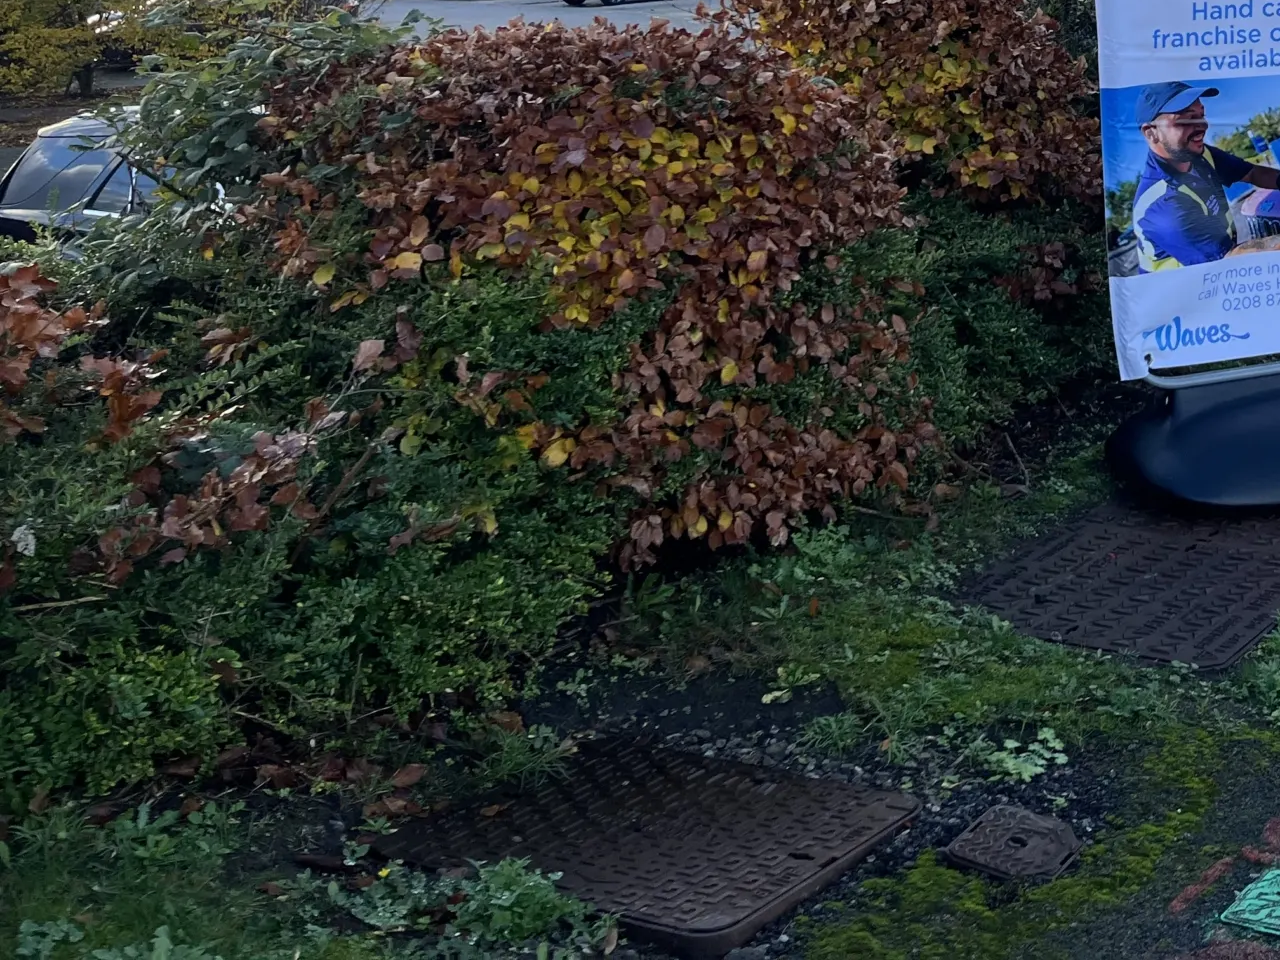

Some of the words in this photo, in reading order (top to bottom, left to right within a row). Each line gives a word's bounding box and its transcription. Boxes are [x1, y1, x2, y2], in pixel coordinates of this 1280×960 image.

[1152, 25, 1262, 49] franchise
[1203, 271, 1222, 286] For
[1225, 265, 1263, 279] more
[1198, 285, 1219, 301] call
[1222, 280, 1272, 295] Waves
[1222, 295, 1261, 312] 0208
[1142, 316, 1250, 351] Waves
